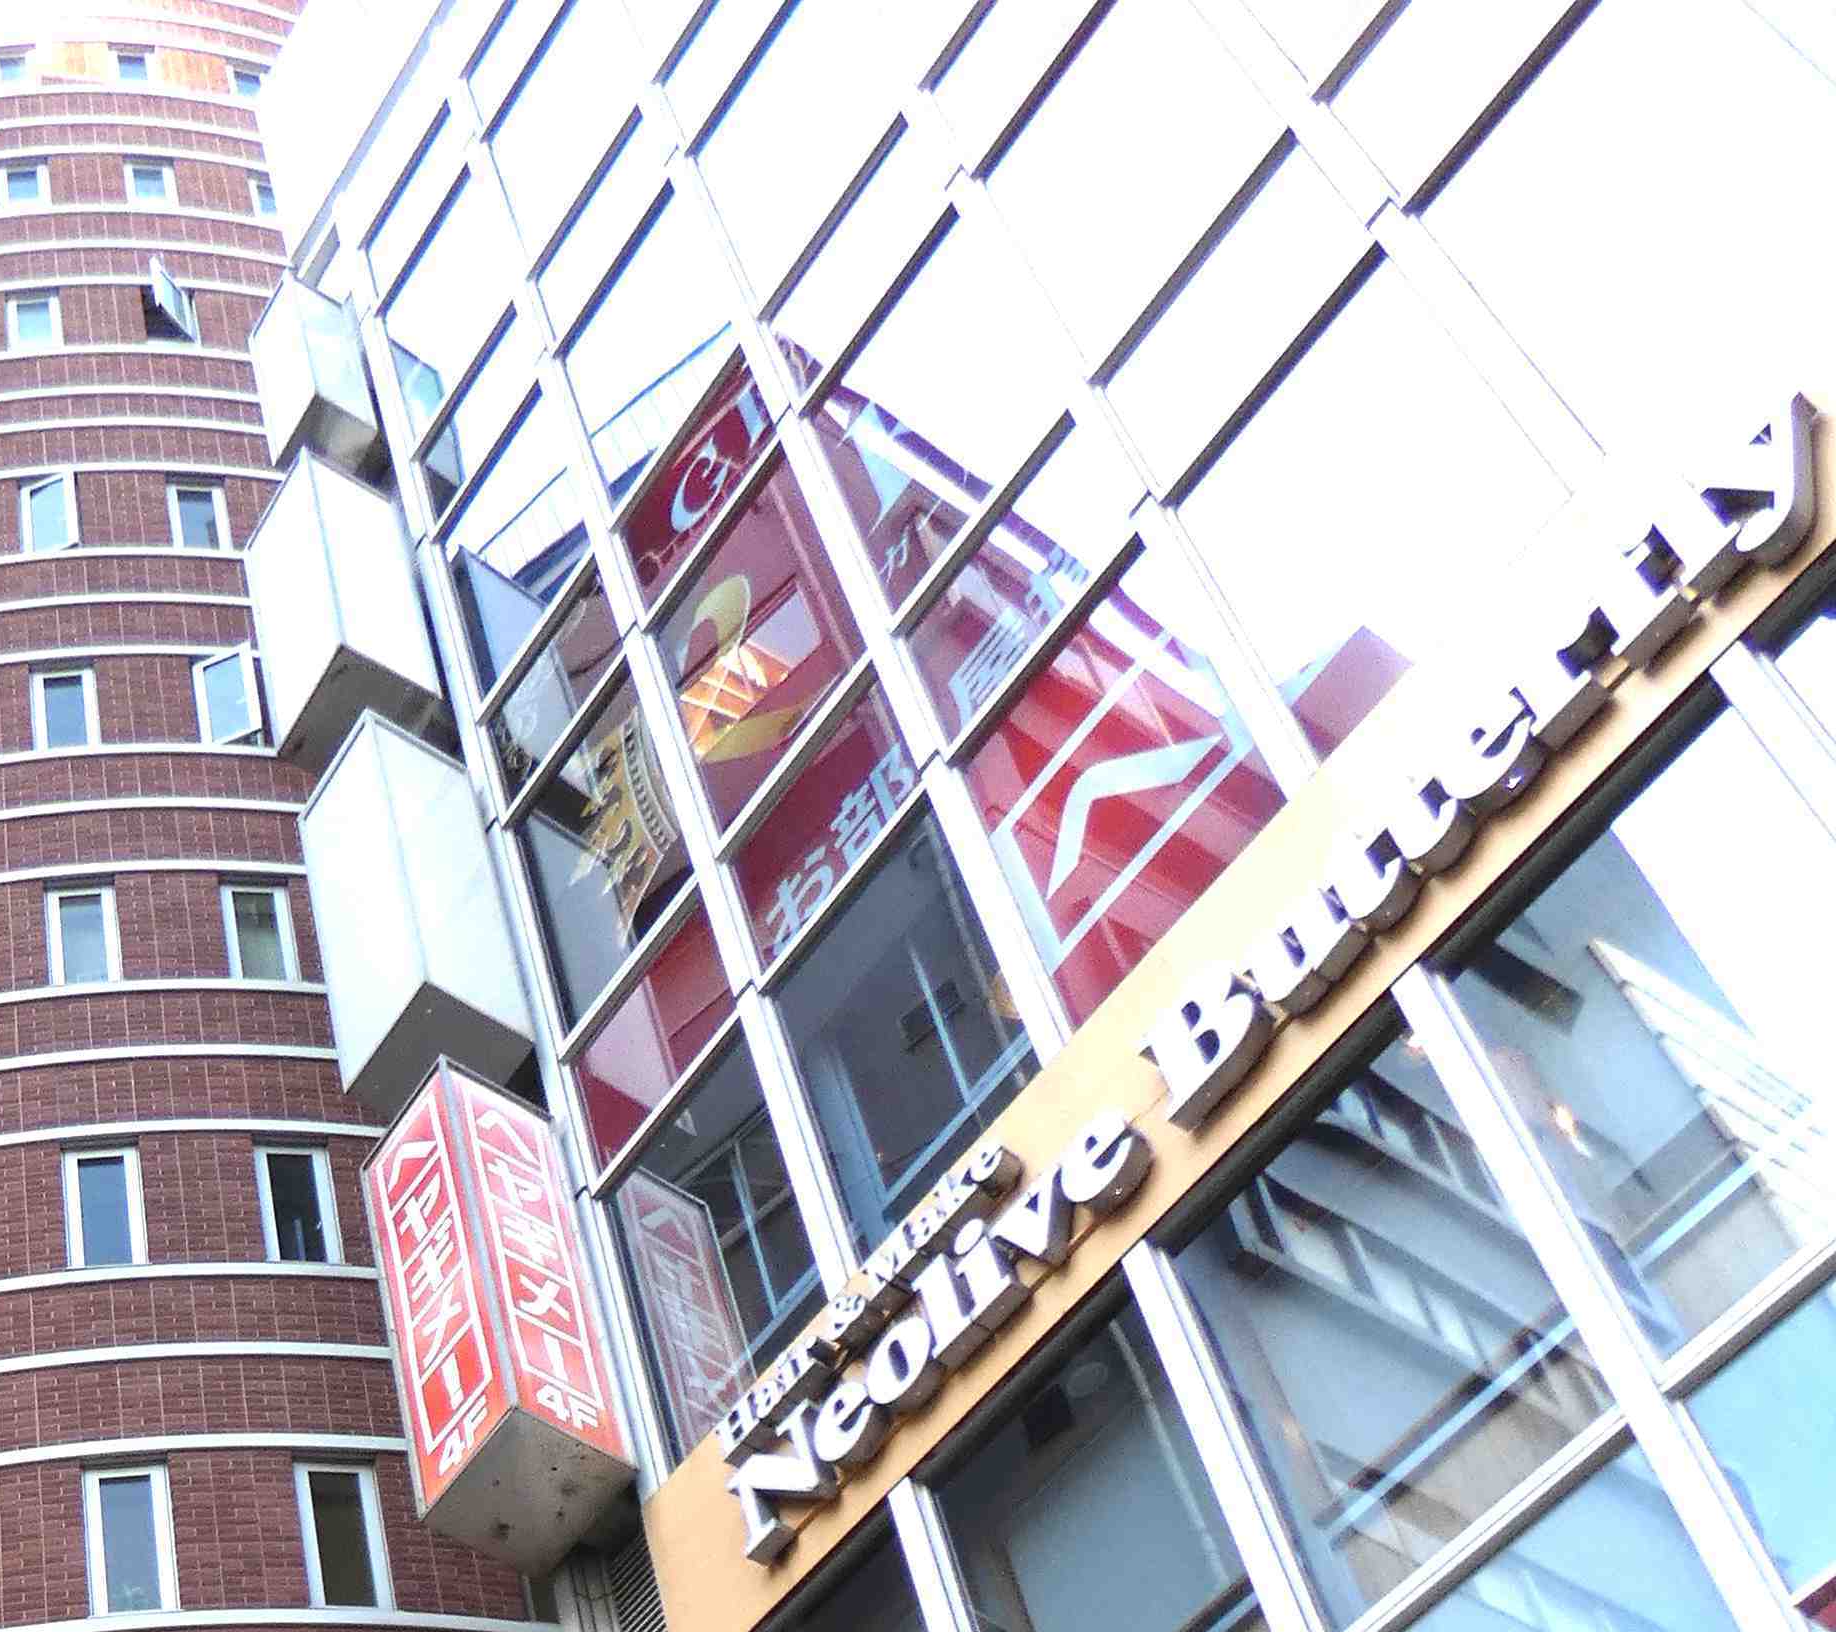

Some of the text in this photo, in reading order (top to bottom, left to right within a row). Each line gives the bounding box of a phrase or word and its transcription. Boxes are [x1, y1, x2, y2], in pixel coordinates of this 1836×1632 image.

[714, 1145, 1006, 1456] Hair & Make
[727, 1113, 1149, 1562] Neolive
[437, 1403, 490, 1479] 4F
[536, 1383, 604, 1432] 4F
